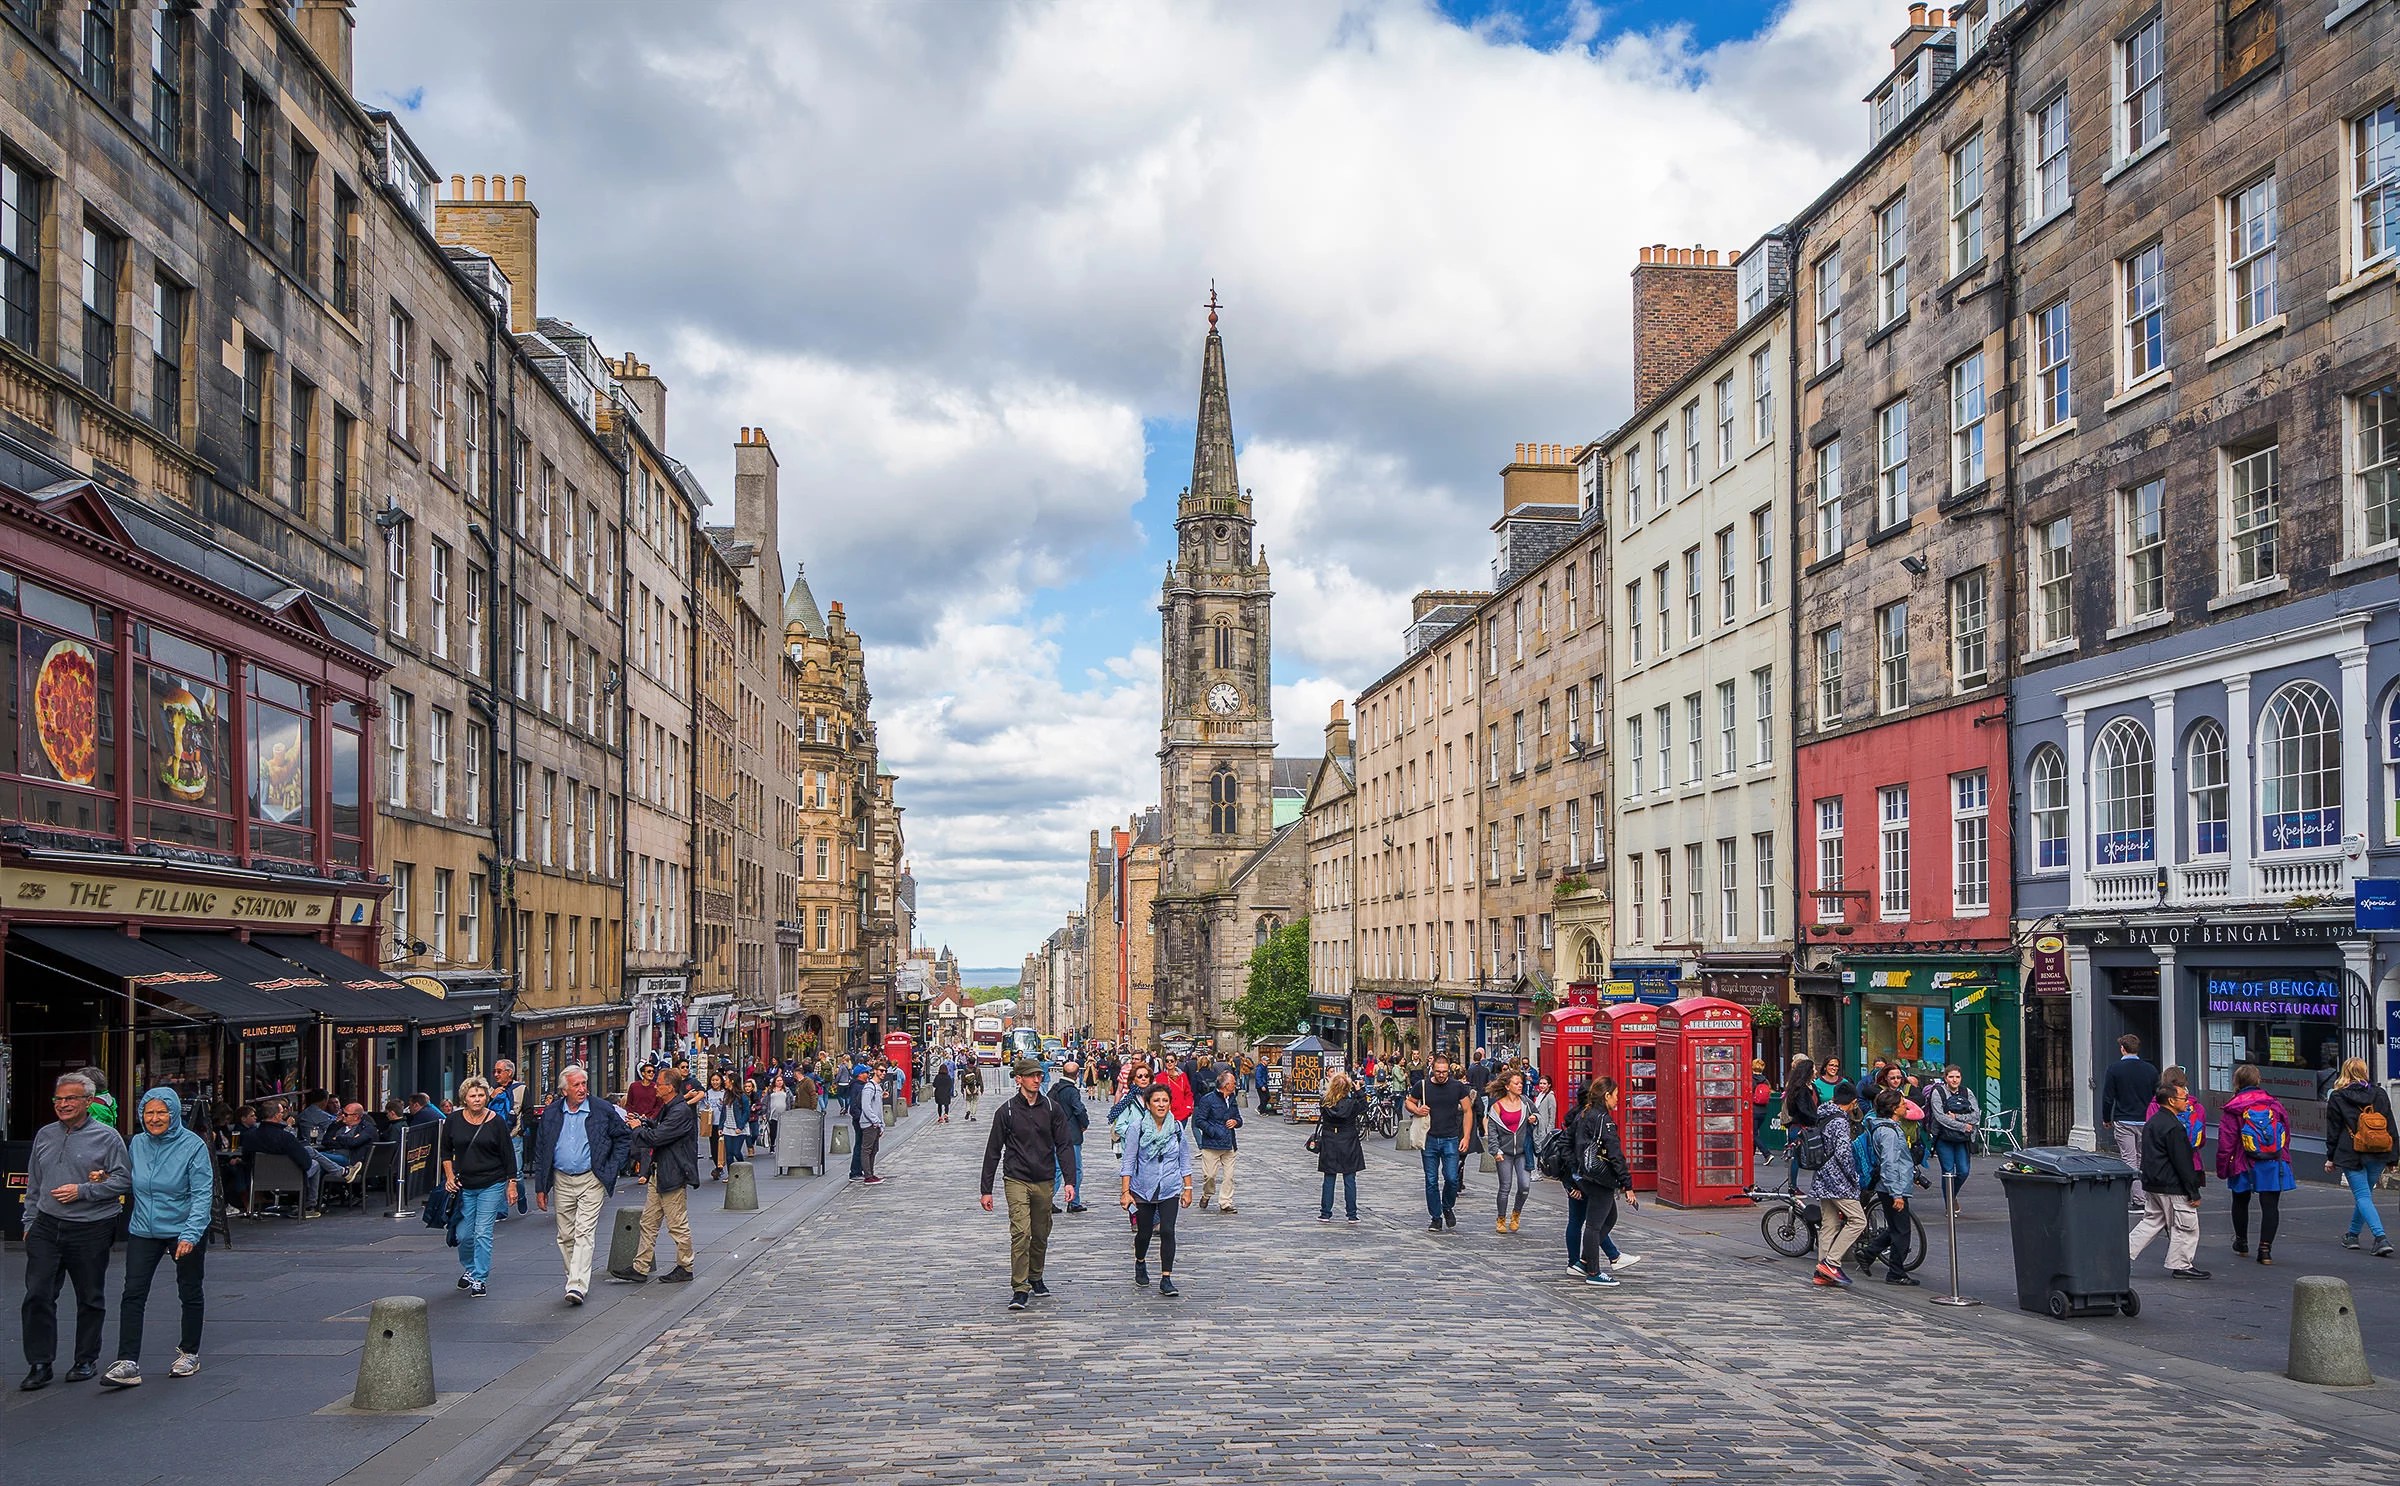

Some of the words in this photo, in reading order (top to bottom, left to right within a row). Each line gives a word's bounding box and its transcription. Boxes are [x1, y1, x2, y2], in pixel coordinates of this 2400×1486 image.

[17, 881, 47, 899] 235
[70, 882, 117, 908] THE
[136, 887, 217, 913] FILLING
[232, 895, 297, 918] STATION
[305, 904, 321, 917] 235
[2130, 929, 2158, 944] BAY
[2170, 928, 2190, 943] OF
[2204, 926, 2281, 942] BENGAL
[2295, 928, 2318, 937] EST.
[2326, 926, 2353, 937] 1978
[1870, 970, 1912, 988] SUBWAY
[2209, 980, 2236, 995] BAY
[2242, 982, 2263, 997] OF
[2269, 981, 2339, 998] BENGAL
[1954, 986, 1988, 1012] SUBWAY
[2209, 1001, 2252, 1013] INDIAN
[2253, 1001, 2339, 1016] RESTAURANT
[242, 1026, 268, 1037] FILLING
[269, 1024, 297, 1035] STATION
[337, 1026, 354, 1035] PIZZA
[356, 1025, 375, 1034] PASTA
[378, 1025, 404, 1033] BURGERS
[1691, 1020, 1742, 1029] TELEPHONE
[1295, 1055, 1319, 1067] FREE
[1324, 1055, 1345, 1066] FREE
[1292, 1066, 1323, 1080] GHOST
[1985, 1013, 2001, 1137] SUBWAY
[1294, 1079, 1321, 1091] TOUR
